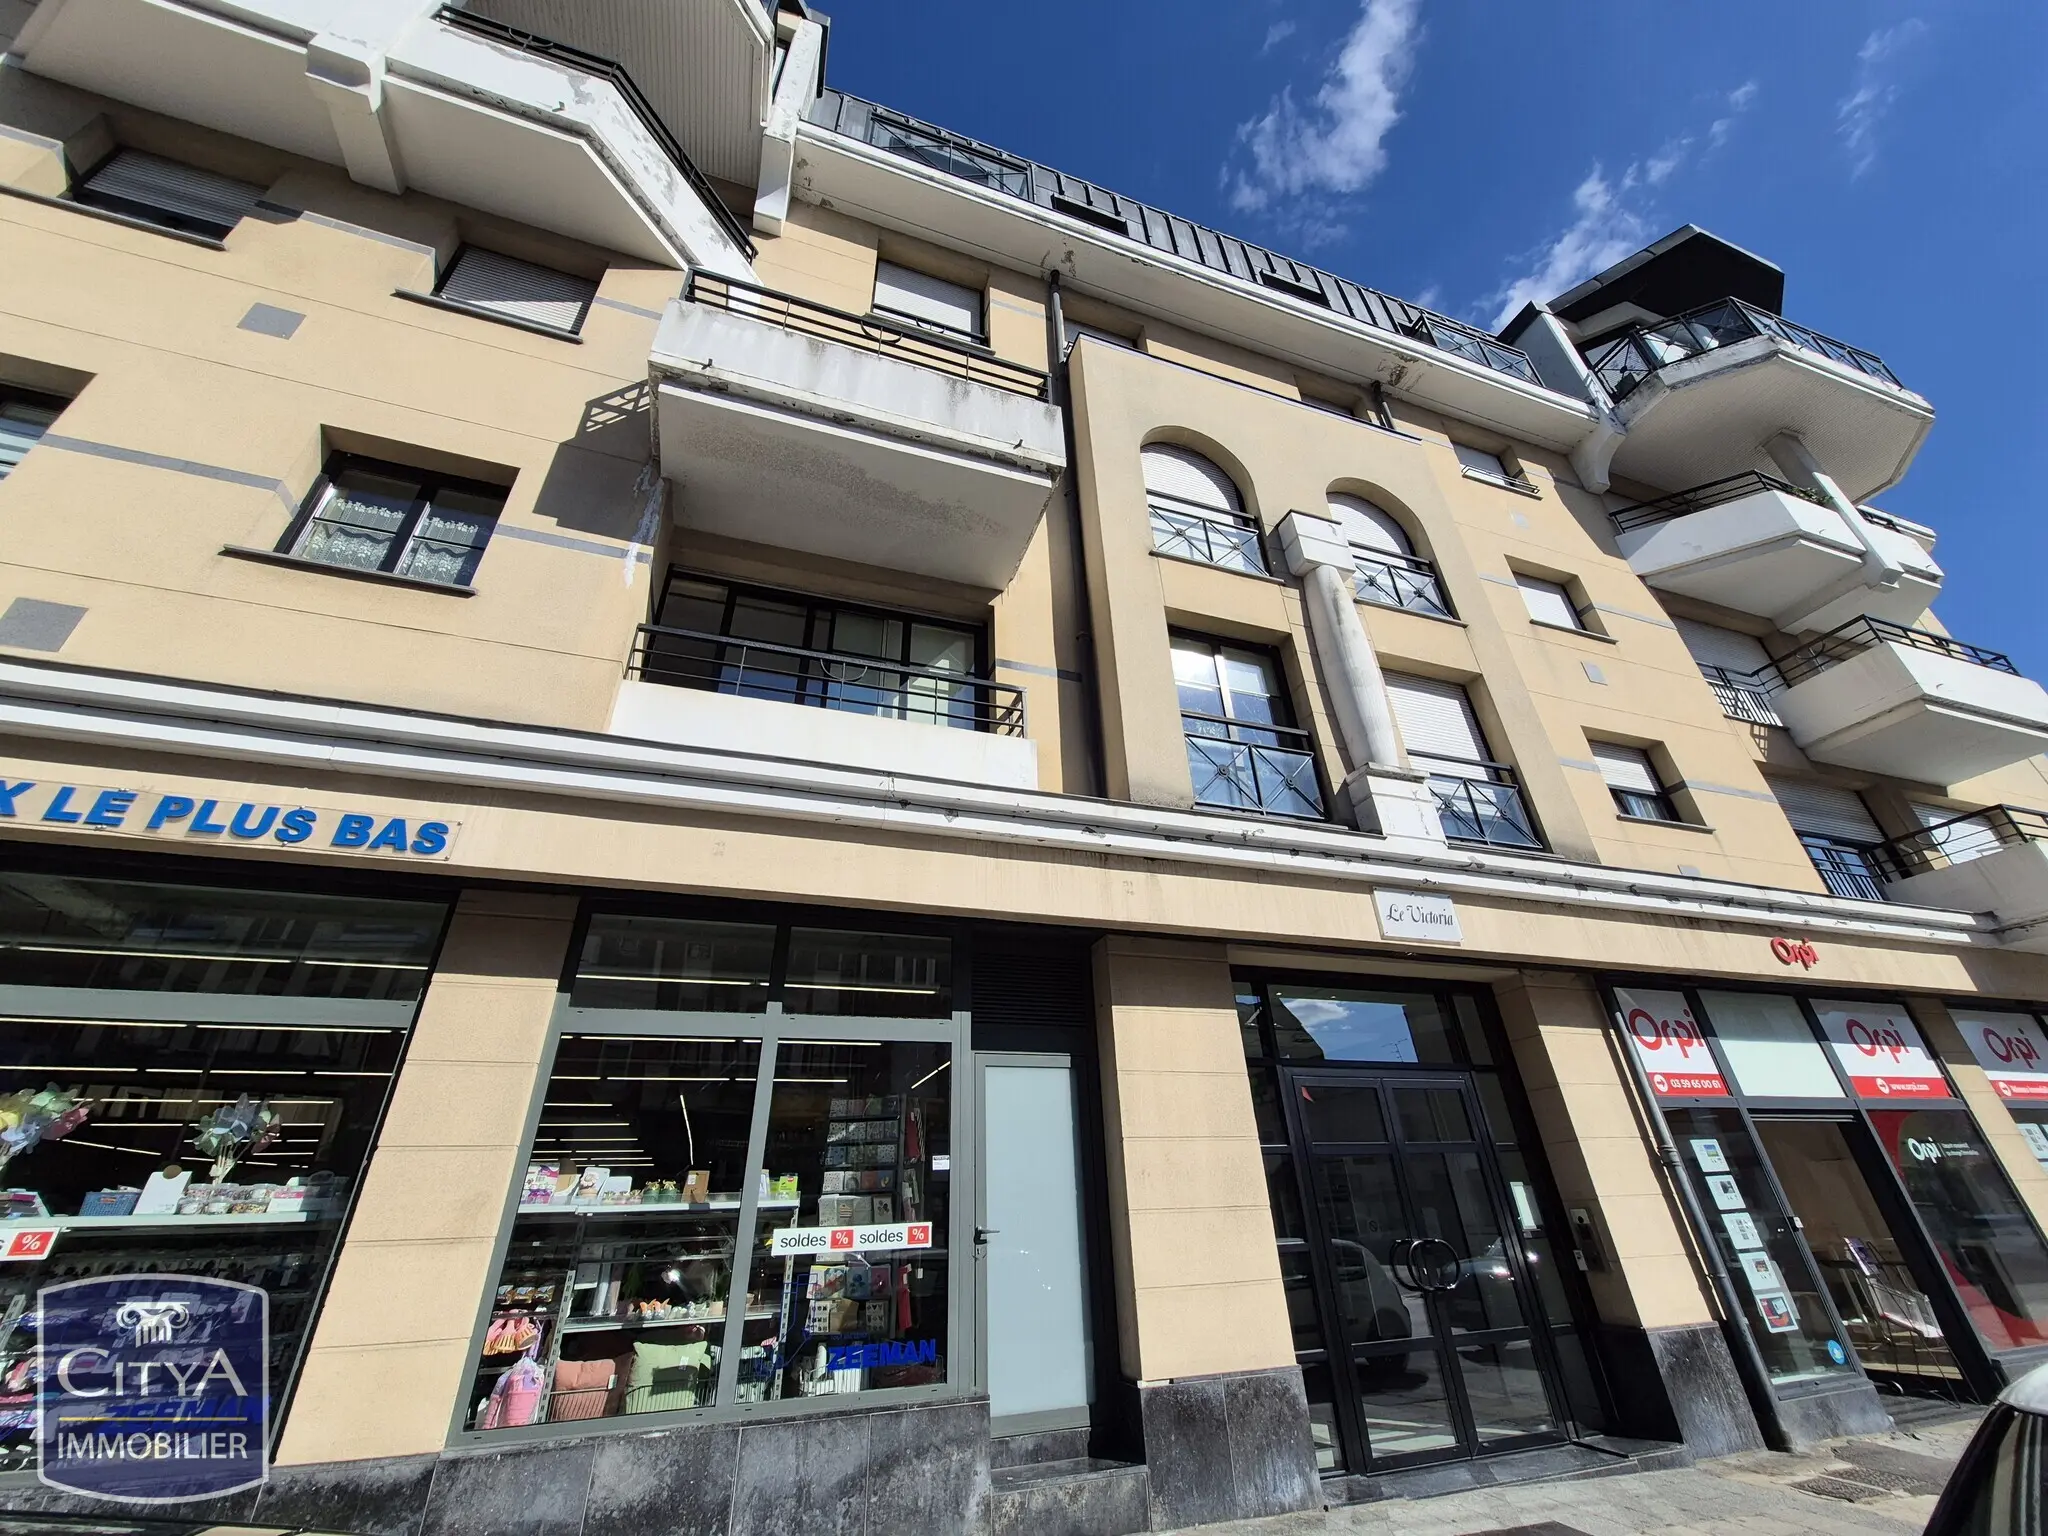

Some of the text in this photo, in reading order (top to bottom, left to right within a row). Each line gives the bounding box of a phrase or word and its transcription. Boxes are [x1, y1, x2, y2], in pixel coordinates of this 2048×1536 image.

[41, 786, 139, 827] LE
[145, 795, 317, 843] PLUS
[330, 814, 449, 854] BAS
[1387, 904, 1453, 926] Le Victoria
[1770, 936, 1819, 971] Orpi
[1628, 1006, 1705, 1060] Orpi
[1846, 1018, 1910, 1064] Orpi
[1983, 1027, 2042, 1069] Orpi
[1670, 1078, 1722, 1089] 03 59 65 00 61
[1907, 1136, 1941, 1164] Orpi
[22, 1234, 41, 1251] %
[780, 1228, 925, 1248] soldes % soldes %
[827, 1339, 936, 1371] ZEEMAN
